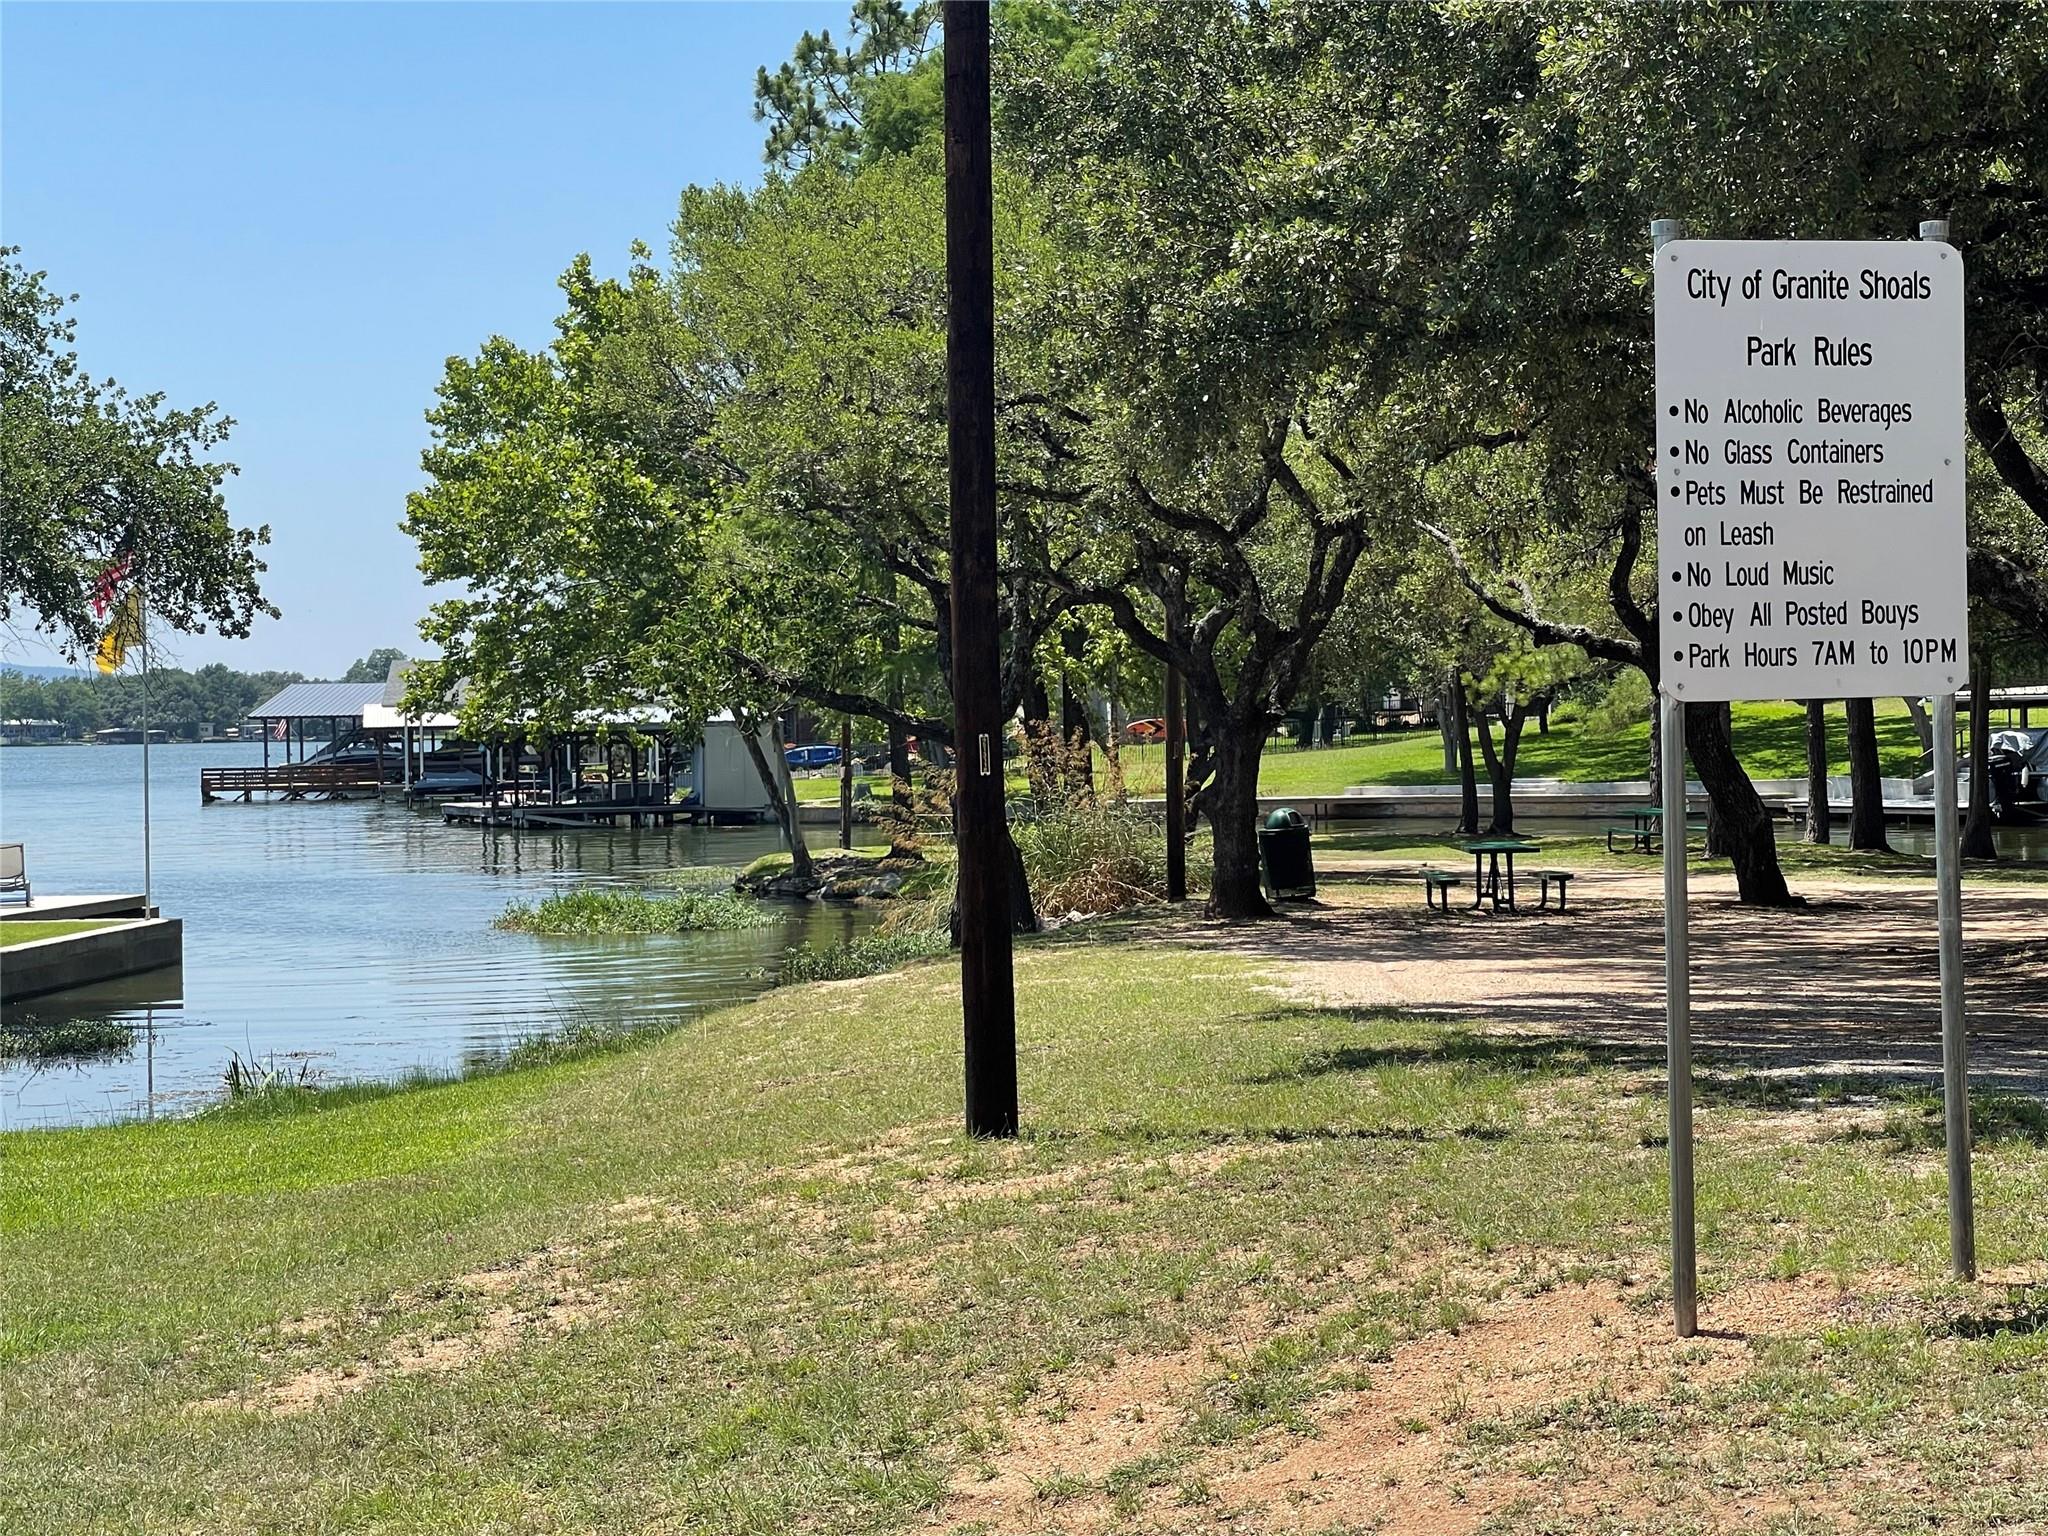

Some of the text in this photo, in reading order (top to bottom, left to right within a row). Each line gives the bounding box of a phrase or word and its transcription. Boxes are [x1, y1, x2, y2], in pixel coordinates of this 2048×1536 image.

[1688, 268, 1932, 308] City of Granite Shoals
[1747, 336, 1873, 367] Park Rules
[1684, 398, 1912, 432] No Alcoholic Beverages
[1685, 439, 1884, 465] No Glass Containers
[1686, 478, 1933, 506] Pets Must Be Restrained
[1684, 521, 1774, 547] on Leash
[1687, 560, 1834, 588] No Loud Music
[1688, 600, 1919, 635] Obey All Posted Bouys
[1688, 638, 1957, 669] Park Hours 7AM to 10PM
